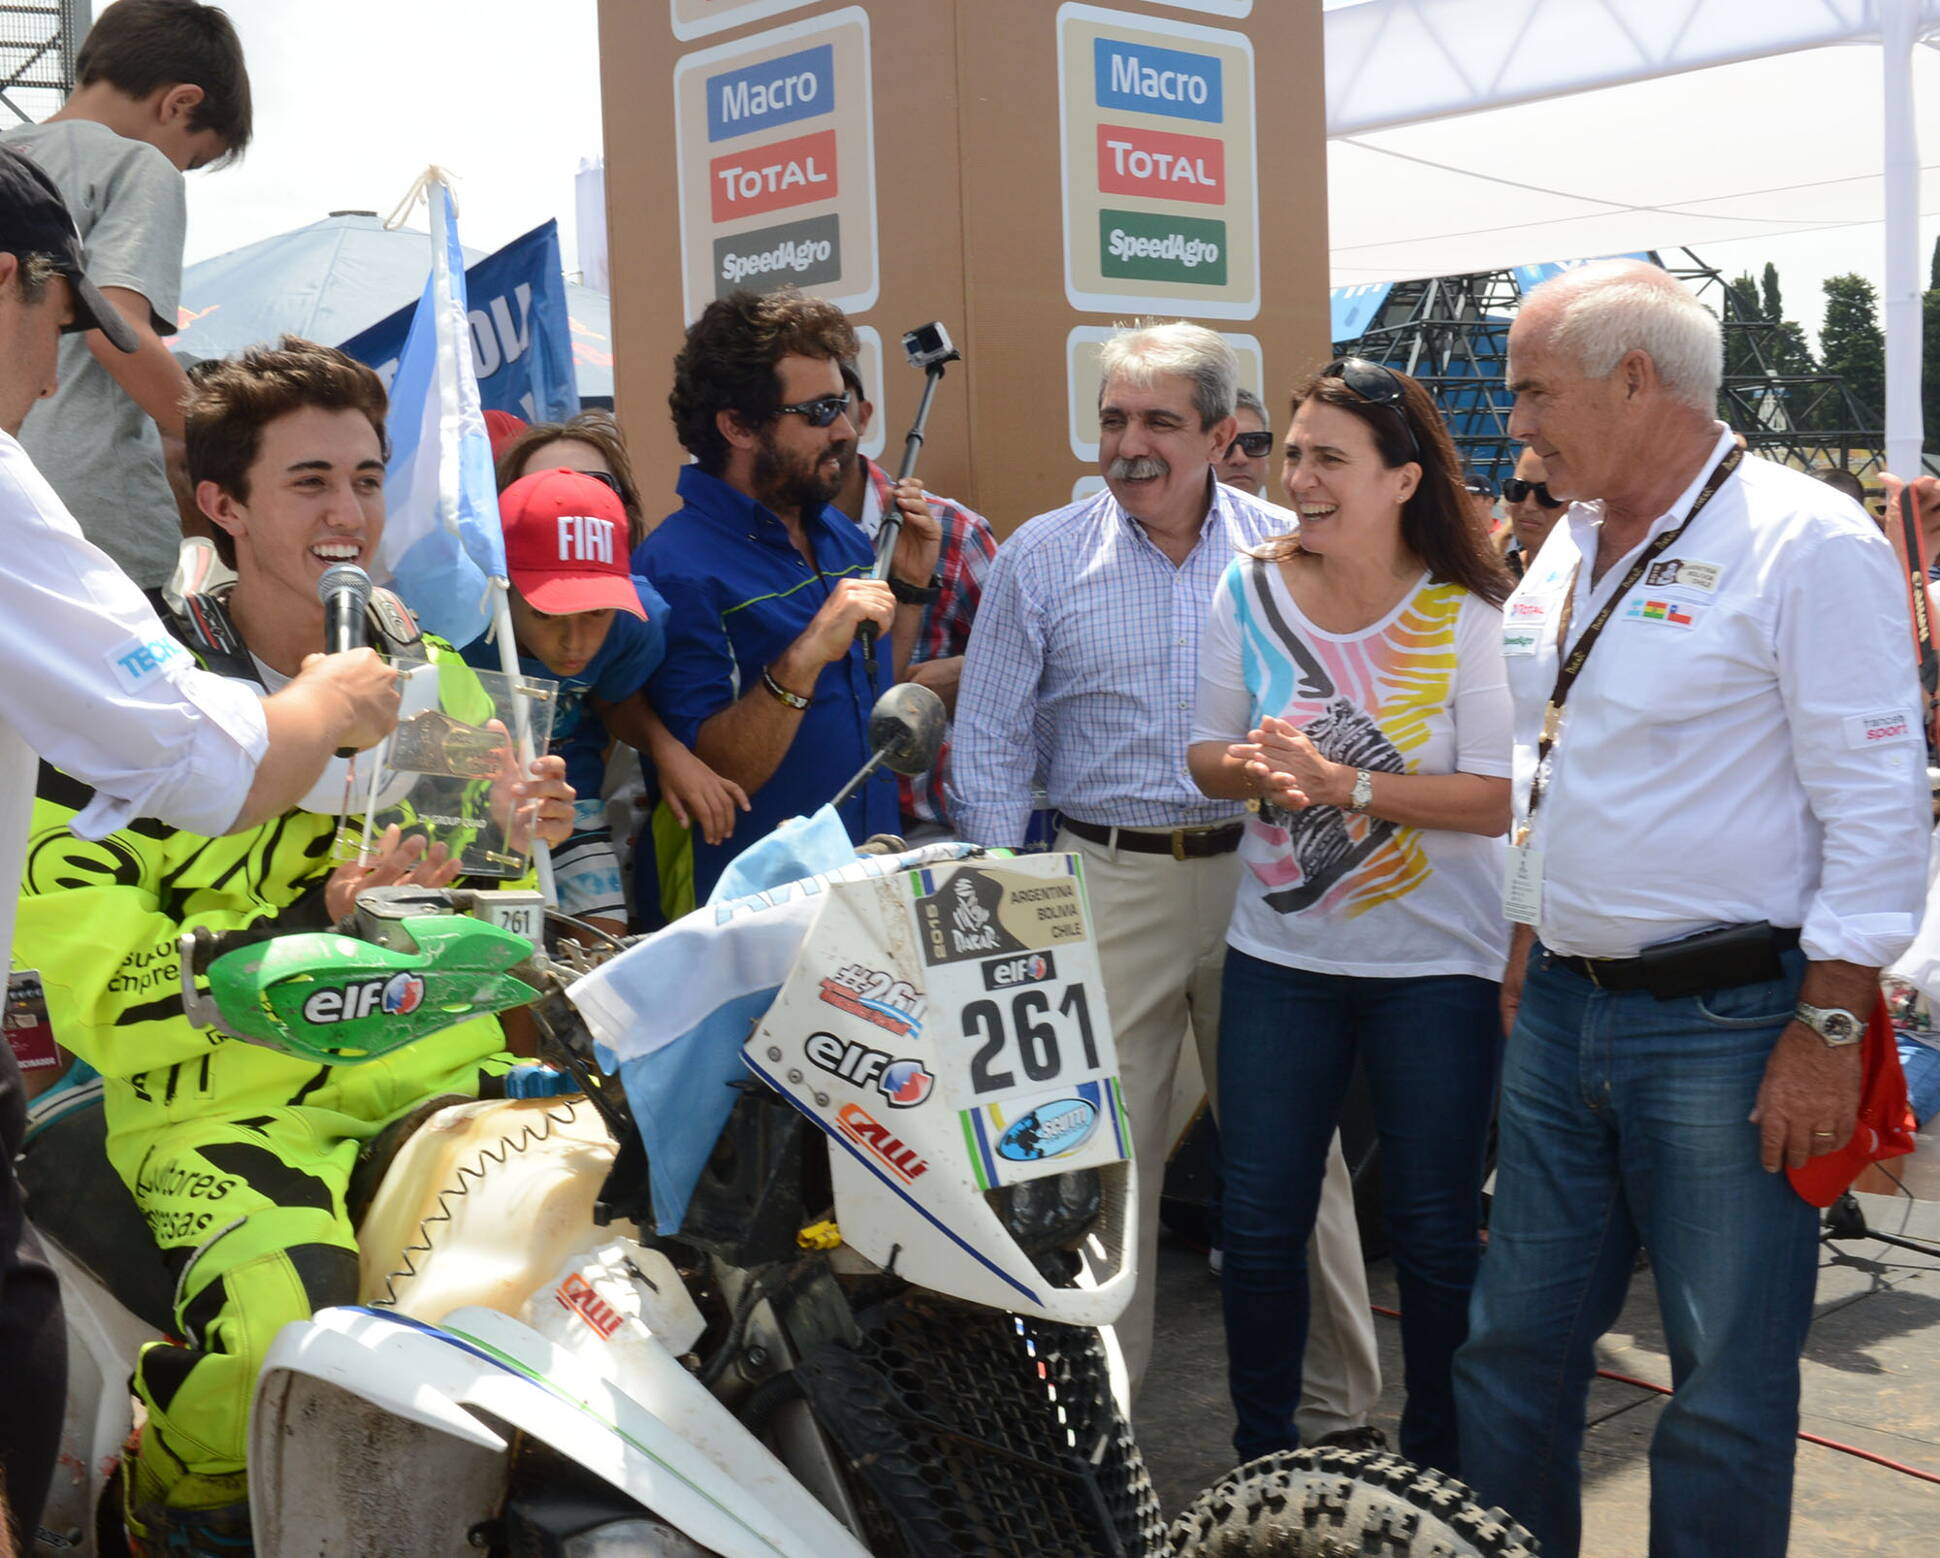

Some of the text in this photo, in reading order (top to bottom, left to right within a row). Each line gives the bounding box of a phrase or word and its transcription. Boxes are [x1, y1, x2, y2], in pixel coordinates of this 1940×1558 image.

[721, 71, 818, 123] Macro
[1110, 53, 1208, 105] Macro
[718, 156, 828, 201] TOTAL
[1106, 139, 1216, 186] TOTAL
[721, 239, 831, 283] SpeedAgro
[1108, 229, 1219, 267] SpeedAgro
[556, 515, 616, 565] FIAT
[1866, 724, 1909, 740] sport
[1009, 885, 1074, 905] ARGENTINA
[1036, 903, 1080, 921] BOLIVIA
[1051, 922, 1083, 939] CHILE
[993, 958, 1030, 985] elf
[303, 980, 386, 1024] elf
[804, 1032, 892, 1088] elf
[961, 982, 1100, 1095] 261
